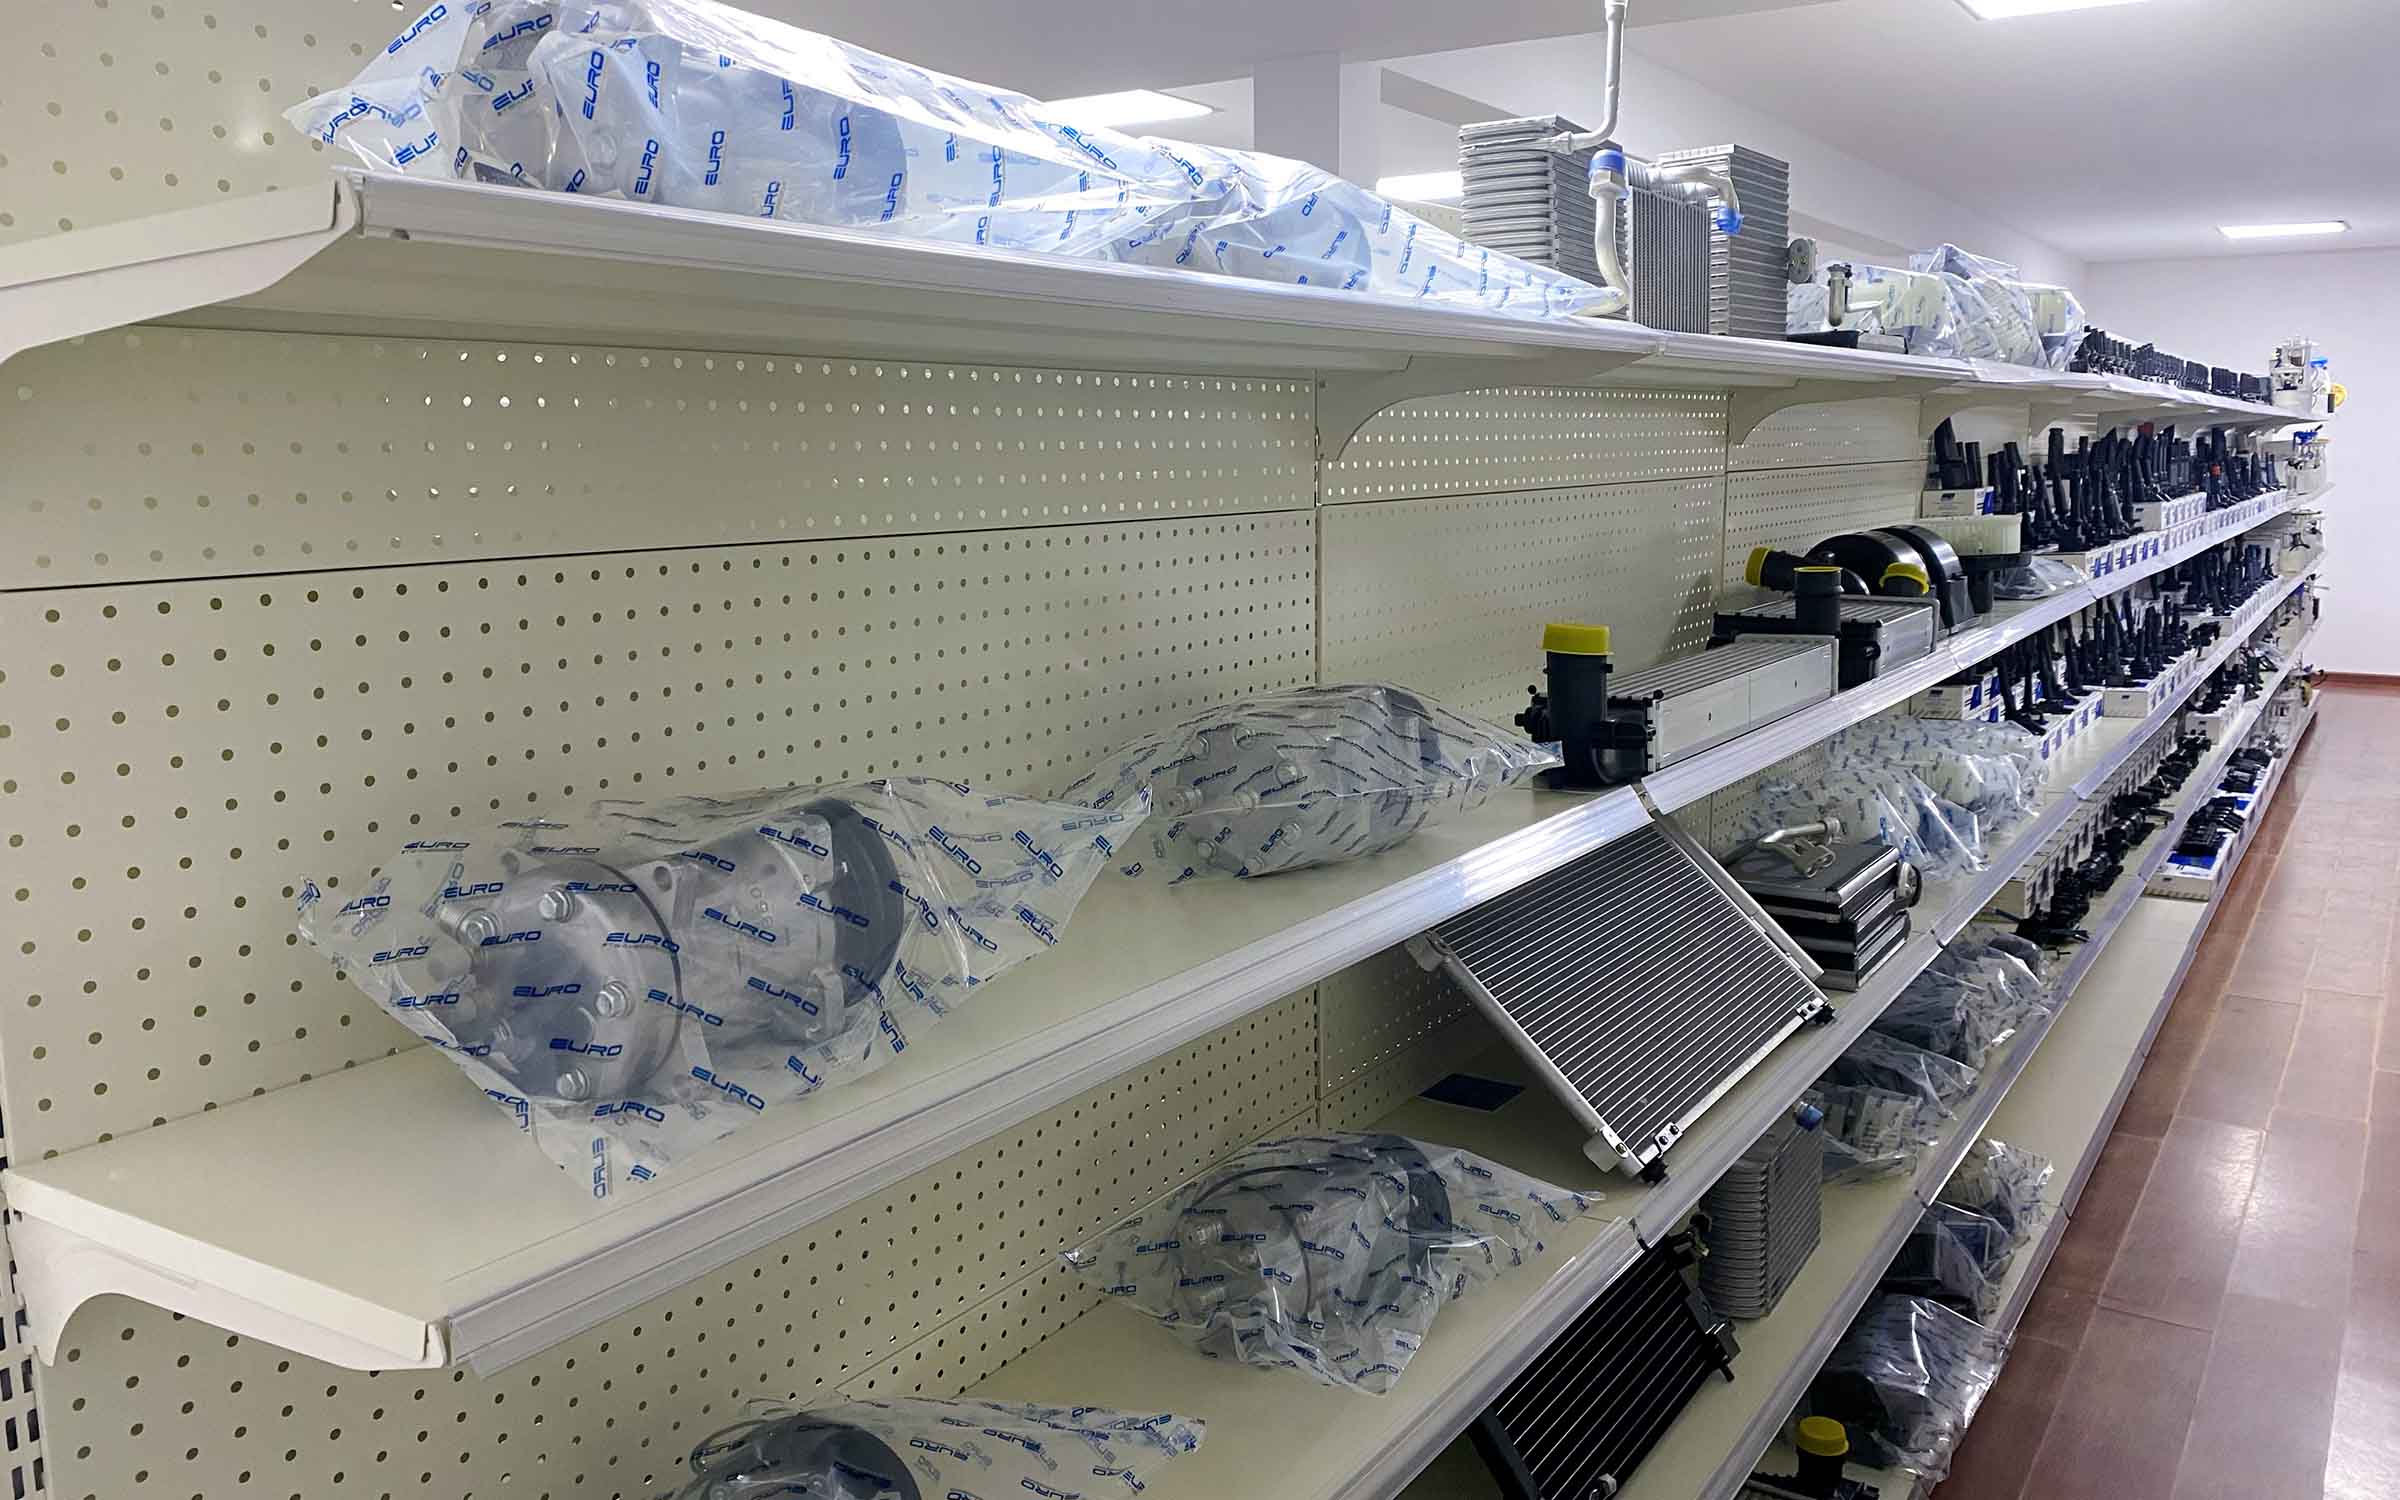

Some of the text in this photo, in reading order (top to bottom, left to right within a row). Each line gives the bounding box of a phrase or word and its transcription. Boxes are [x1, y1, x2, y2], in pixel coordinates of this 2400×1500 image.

[387, 4, 447, 54] EURO
[483, 14, 552, 50] EURO
[583, 51, 604, 120] EURO
[647, 61, 660, 109] EURO
[704, 130, 725, 186] EURO
[833, 116, 851, 181] EURO
[1062, 126, 1117, 170] EURO
[635, 139, 659, 195] EURO
[988, 145, 1002, 208] EURO
[760, 180, 781, 218] URO
[880, 172, 903, 222] EURO
[1151, 755, 1196, 776] EURO
[403, 841, 471, 849] EURO
[759, 827, 829, 857] EURO
[929, 826, 982, 875] EURO
[1015, 830, 1063, 878] EURO
[681, 851, 736, 872] URO
[443, 882, 504, 898] EURO
[566, 882, 638, 893] EURO
[800, 893, 870, 928] EURO
[888, 880, 938, 928] EURO
[704, 907, 776, 943] EURO
[481, 931, 541, 946] EURO
[606, 932, 680, 953] EURO
[372, 946, 430, 962] EURO
[397, 993, 460, 1007] EURO
[512, 983, 582, 998] EURO
[747, 977, 819, 1017] EURO
[648, 988, 723, 1027] EURO
[549, 1038, 624, 1057] EURO
[691, 1065, 765, 1111] EURO
[594, 1100, 665, 1122] EURO
[1454, 1157, 1493, 1178] EURO
[1478, 1204, 1521, 1221] EURO
[1136, 1240, 1180, 1253] EURO
[1221, 1233, 1266, 1242] EURO
[1302, 1240, 1344, 1259] EURO
[1103, 1285, 1136, 1294] URO
[1179, 1274, 1225, 1287] EURO
[910, 1439, 969, 1461] EURO
